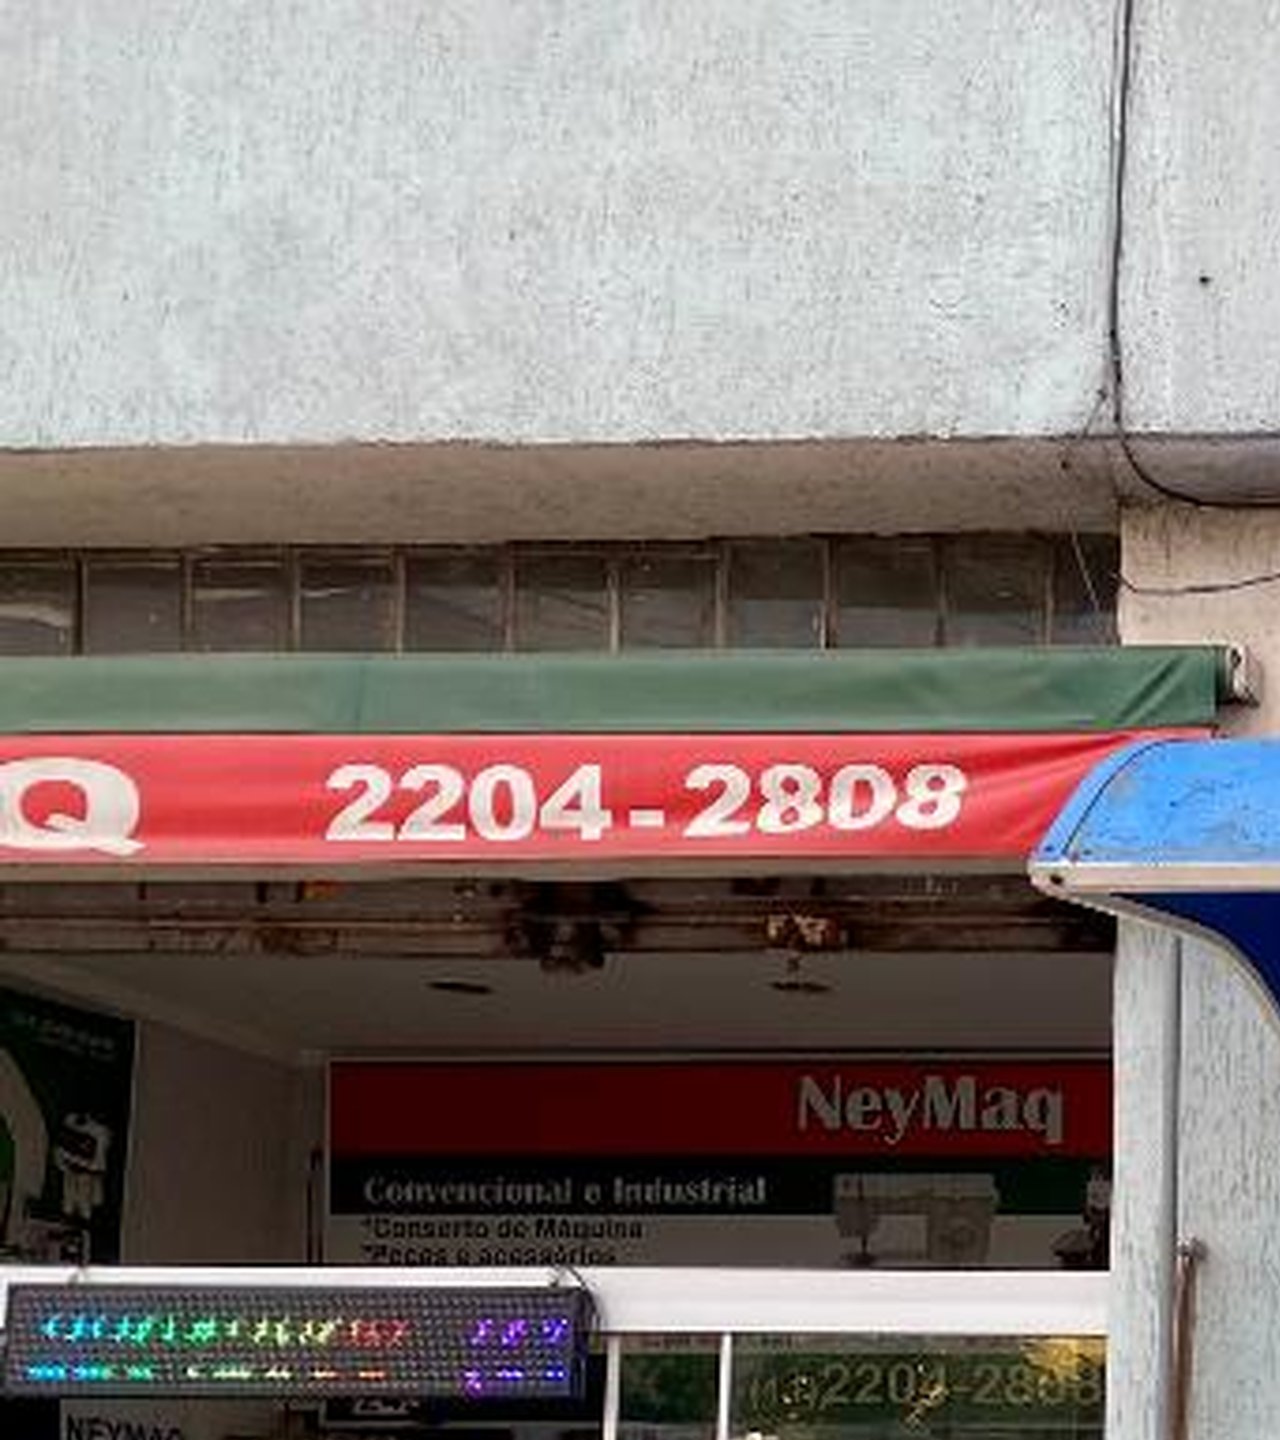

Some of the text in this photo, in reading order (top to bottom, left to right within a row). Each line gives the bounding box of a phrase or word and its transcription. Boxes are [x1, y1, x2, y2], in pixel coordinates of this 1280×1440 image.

[326, 763, 967, 841] 2204-2808
[798, 1074, 1064, 1145] NeyMaq
[364, 1176, 572, 1205] Convencional
[613, 1175, 767, 1204] Industrial
